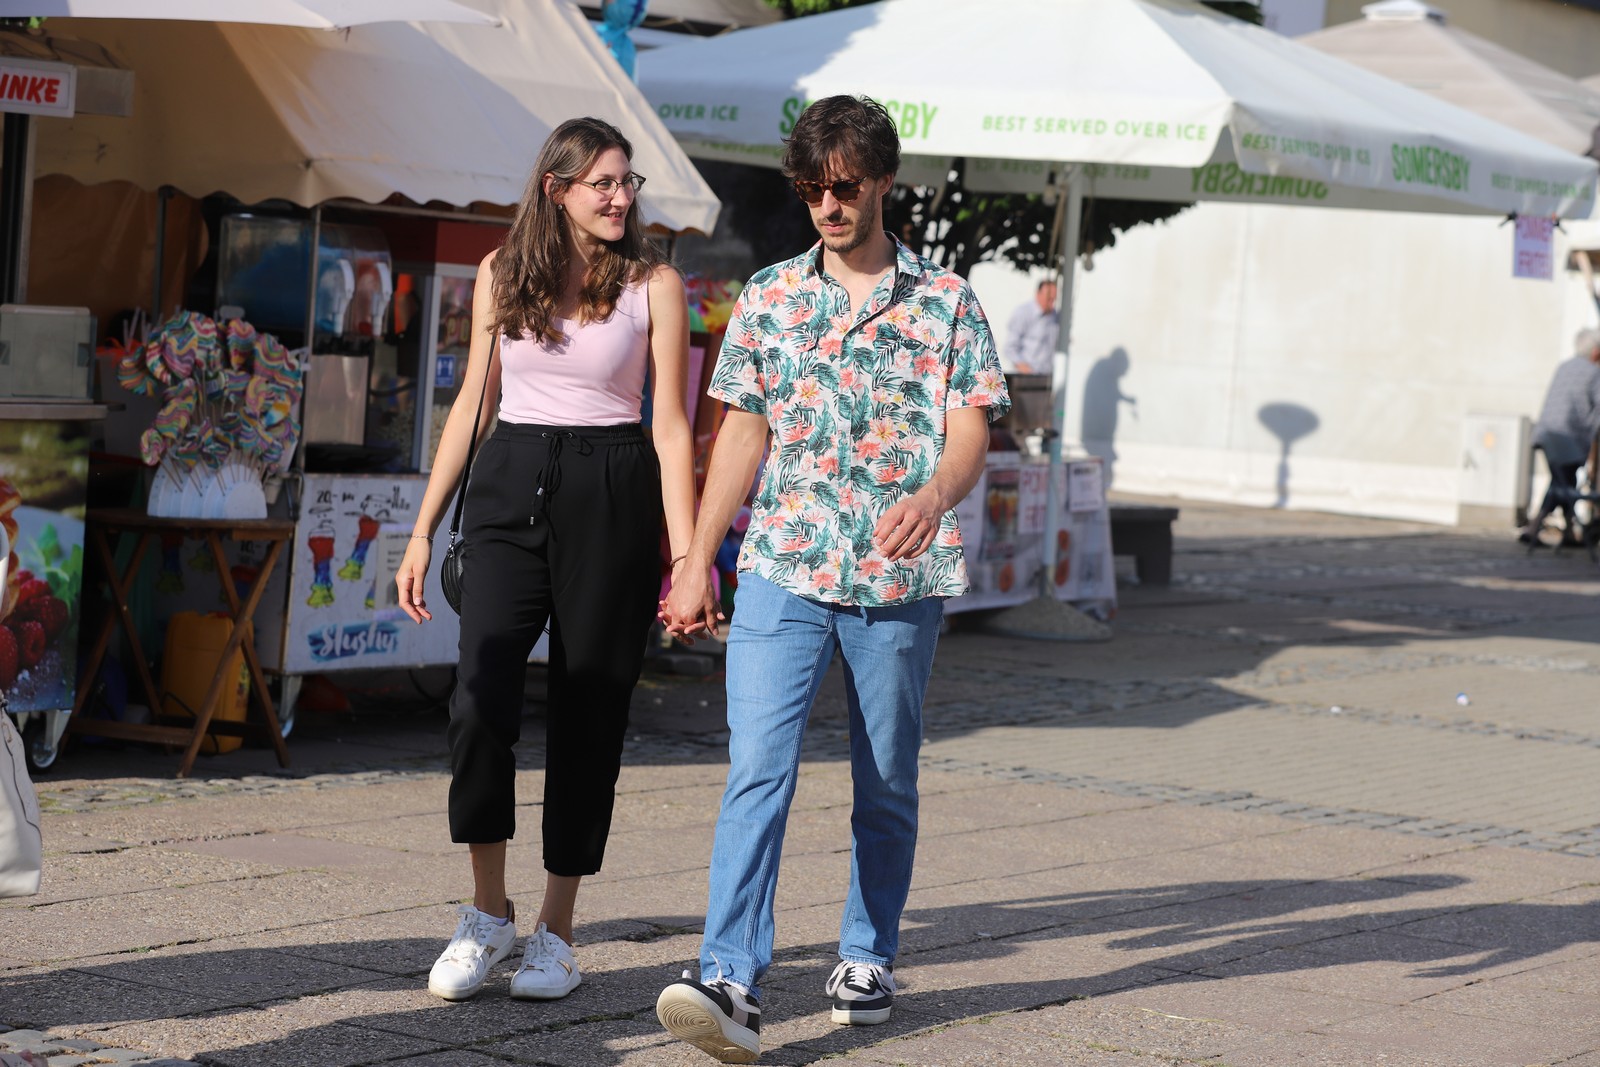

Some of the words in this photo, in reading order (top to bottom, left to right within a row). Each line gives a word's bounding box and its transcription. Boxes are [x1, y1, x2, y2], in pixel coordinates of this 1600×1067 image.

[657, 103, 706, 120] OVER
[711, 104, 739, 122] ICE
[982, 114, 1028, 132] BEST
[1034, 116, 1107, 136] SERVED
[1114, 119, 1169, 139] OVER
[1176, 123, 1208, 142] ICE
[1242, 132, 1277, 151] BEST
[1391, 143, 1471, 193] SOMERSBY
[318, 620, 395, 657] Slushy
